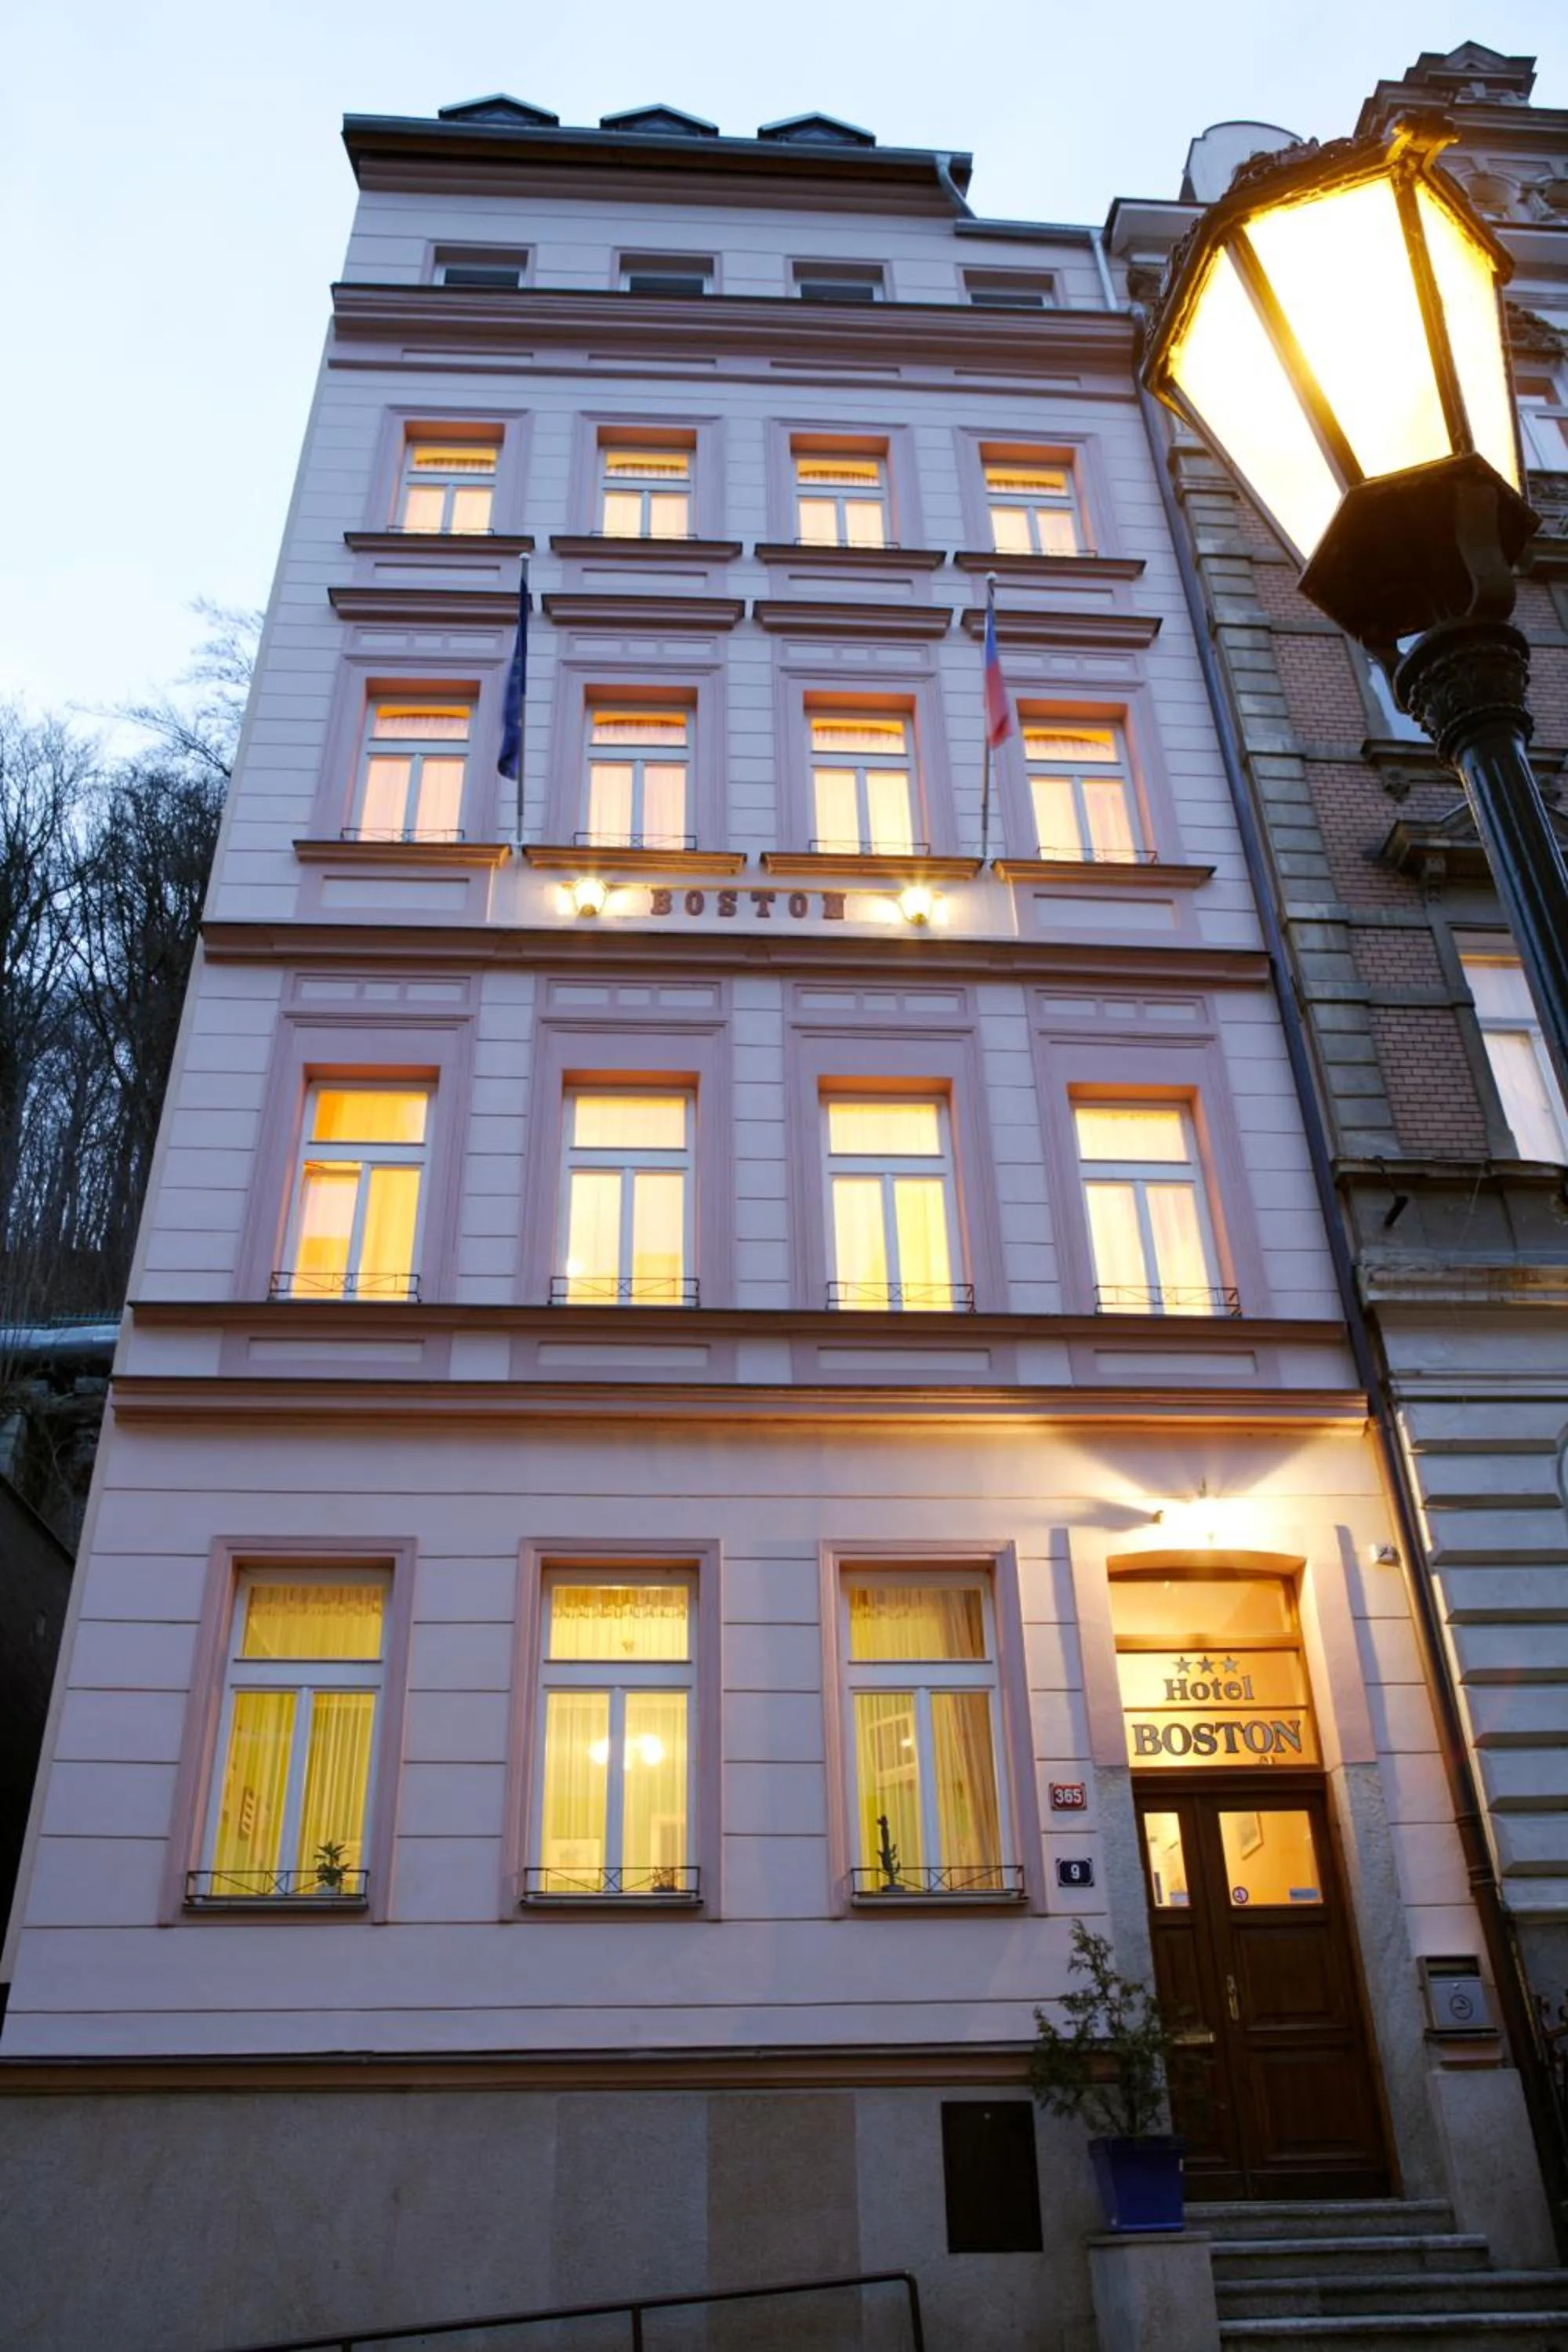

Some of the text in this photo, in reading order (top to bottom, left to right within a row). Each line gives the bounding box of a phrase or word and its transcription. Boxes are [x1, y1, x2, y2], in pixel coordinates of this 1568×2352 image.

[651, 889, 846, 919] BOSTON
[1163, 1675, 1254, 1700] Hotel
[1131, 1719, 1302, 1755] BOSTON
[1054, 1788, 1082, 1804] 365
[1070, 1864, 1080, 1879] 9
